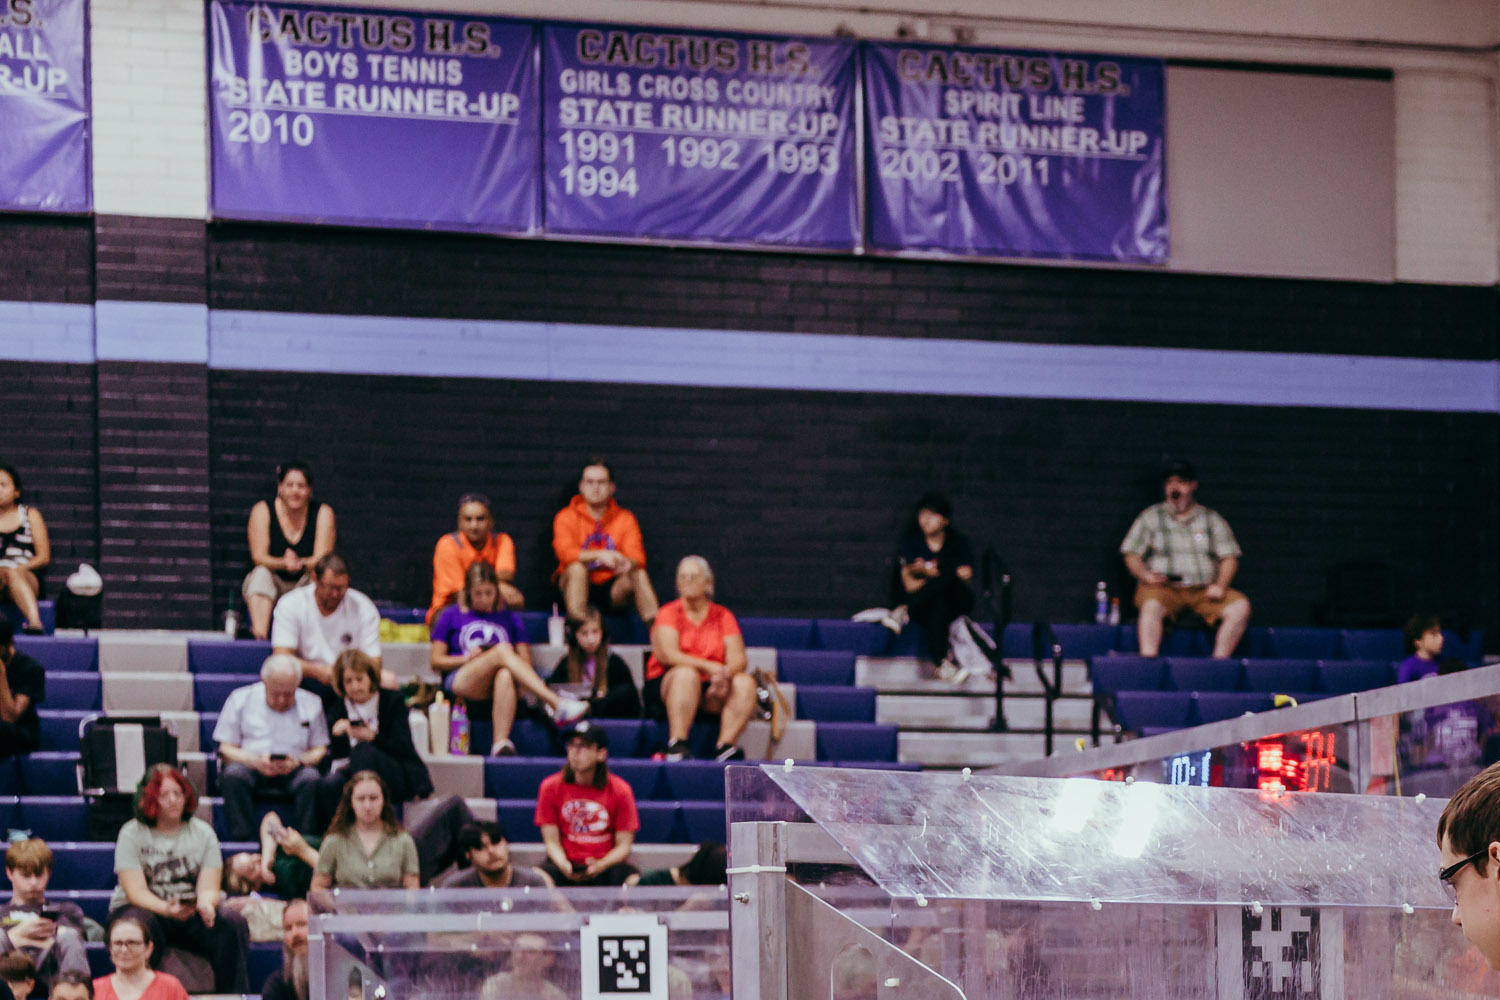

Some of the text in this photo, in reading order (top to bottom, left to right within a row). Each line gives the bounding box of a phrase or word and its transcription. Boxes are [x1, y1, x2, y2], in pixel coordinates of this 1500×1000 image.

[248, 9, 501, 58] CACTUS H.S.
[577, 29, 821, 76] CACTUS H.S.
[285, 50, 463, 86] BOYS TENNIS
[560, 68, 836, 108] GIRLS CROSS COUNTRY
[898, 50, 1130, 96] CACTUS H.S.
[228, 76, 521, 119] STATE RUNNER-UP
[559, 97, 840, 138] STATE RUNNER-UP
[944, 89, 1086, 123] SPIRIT LINE
[228, 111, 314, 147] 2010
[880, 116, 1148, 155] STATE RUNNER-UP
[559, 130, 840, 176] 1991 1992 1993
[880, 150, 1049, 186] 2002 2011
[559, 164, 639, 198] 1994
